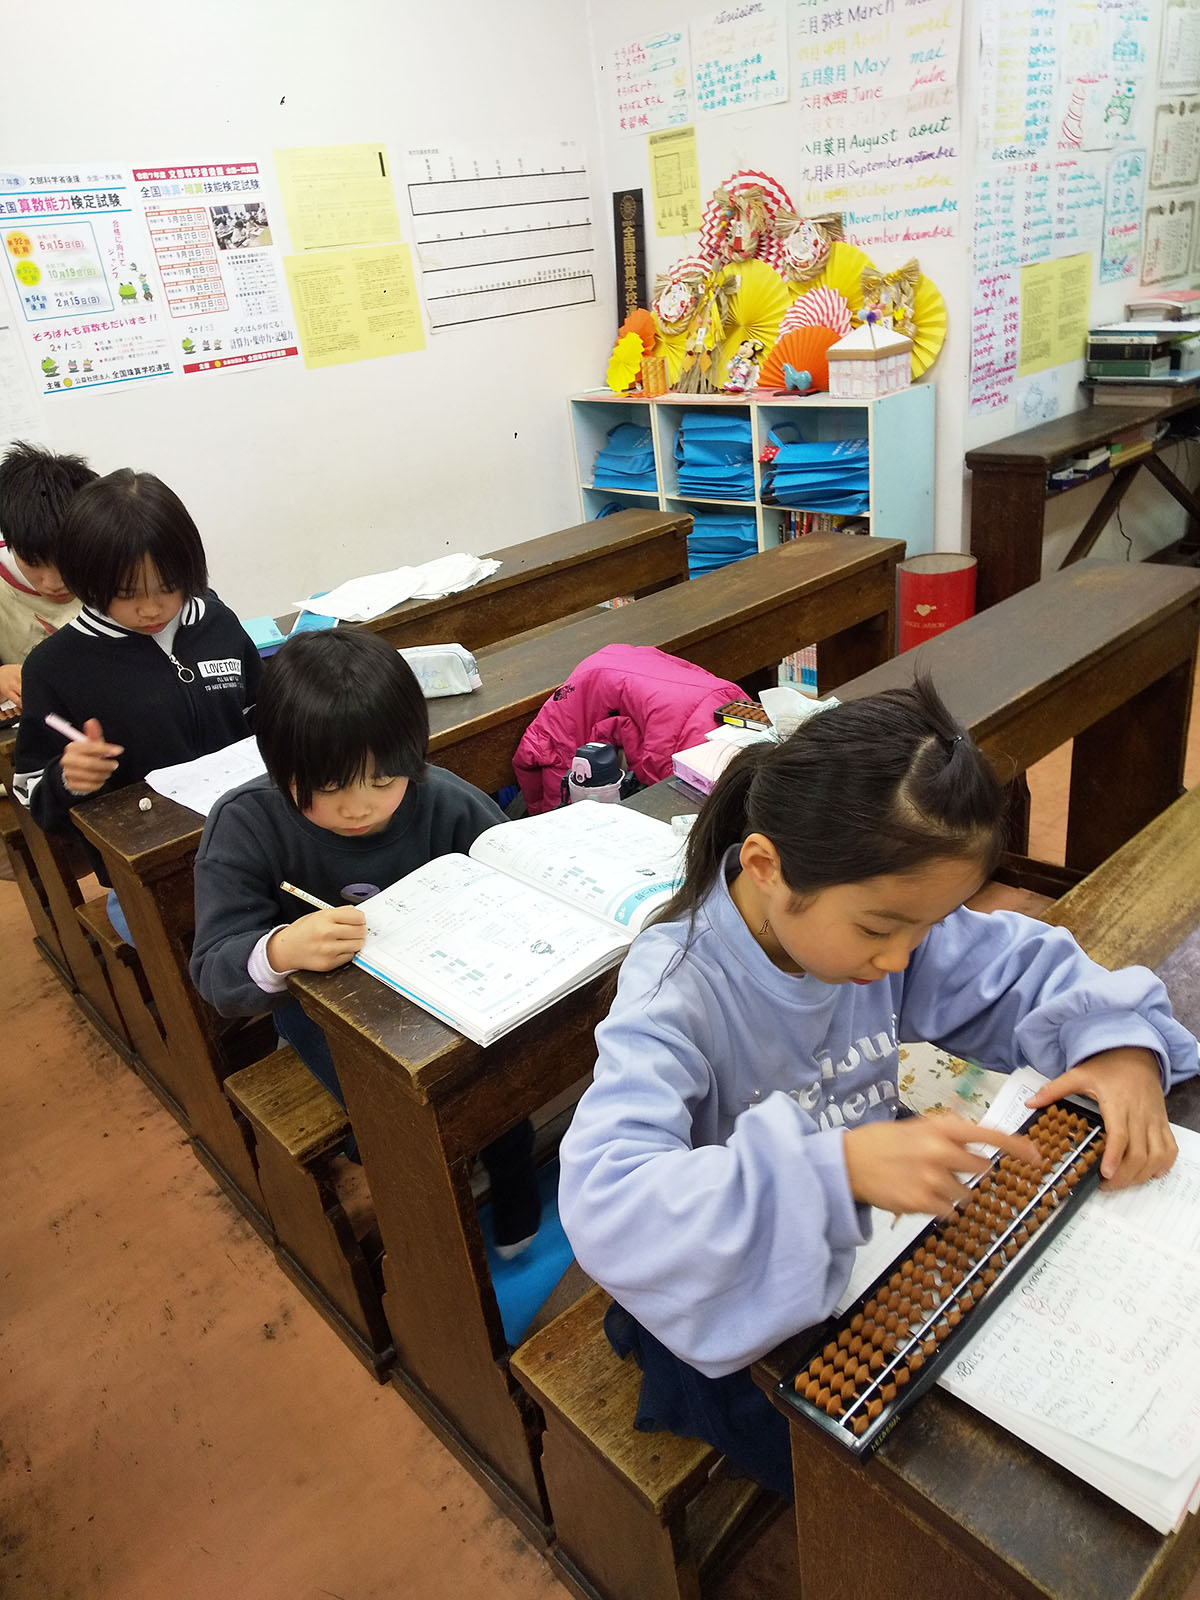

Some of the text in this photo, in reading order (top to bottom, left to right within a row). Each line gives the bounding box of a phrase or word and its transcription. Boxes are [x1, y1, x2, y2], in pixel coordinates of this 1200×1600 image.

[847, 0, 895, 23] March
[853, 57, 890, 77] May
[909, 38, 945, 64] mai
[849, 86, 884, 104] June
[910, 65, 946, 91] juin
[850, 129, 898, 153] August
[847, 152, 902, 178] September
[849, 206, 902, 225] November
[850, 228, 900, 246] December
